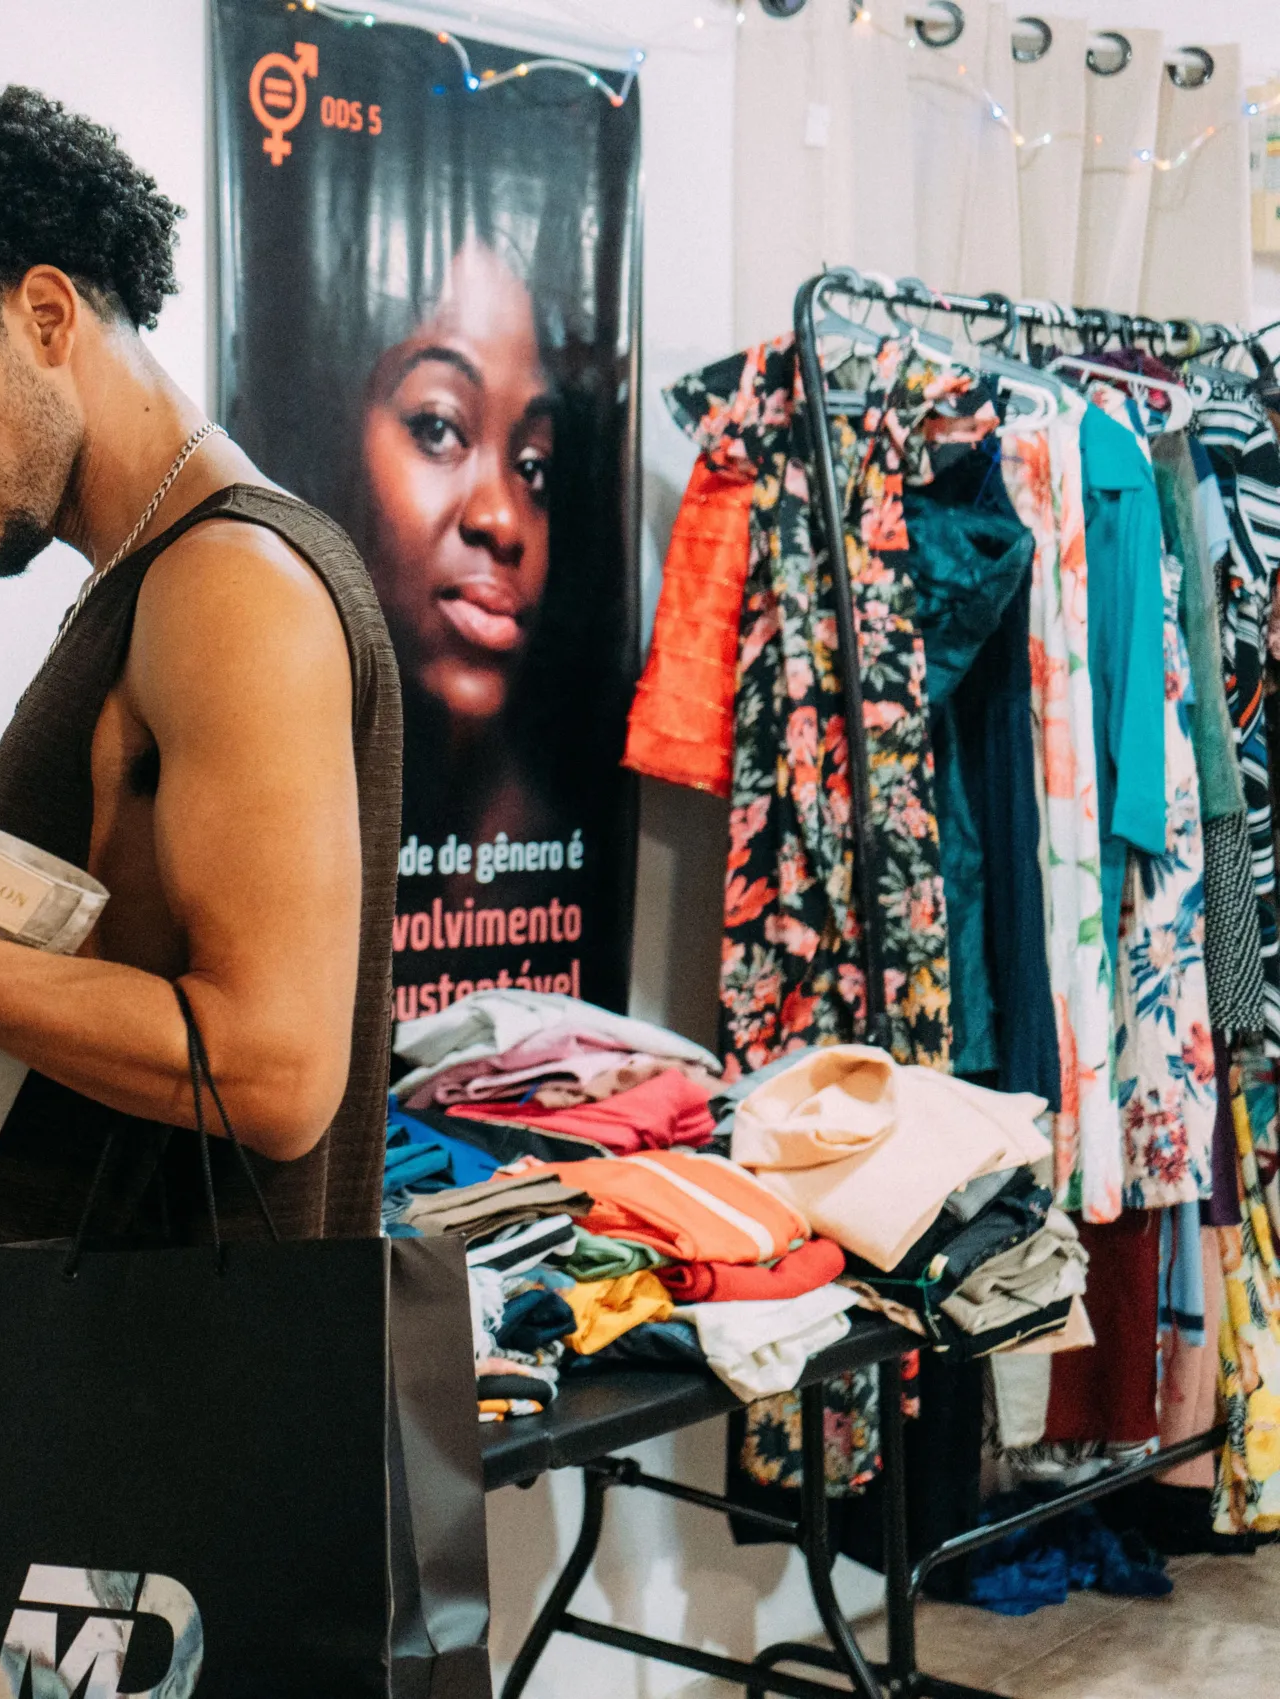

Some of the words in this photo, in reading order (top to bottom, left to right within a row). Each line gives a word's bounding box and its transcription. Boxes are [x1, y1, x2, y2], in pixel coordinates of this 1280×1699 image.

[320, 96, 363, 132] ODS
[368, 105, 382, 136] 5
[397, 834, 434, 876] de
[438, 833, 472, 875] de
[475, 832, 563, 884] gênero
[567, 829, 584, 870] é
